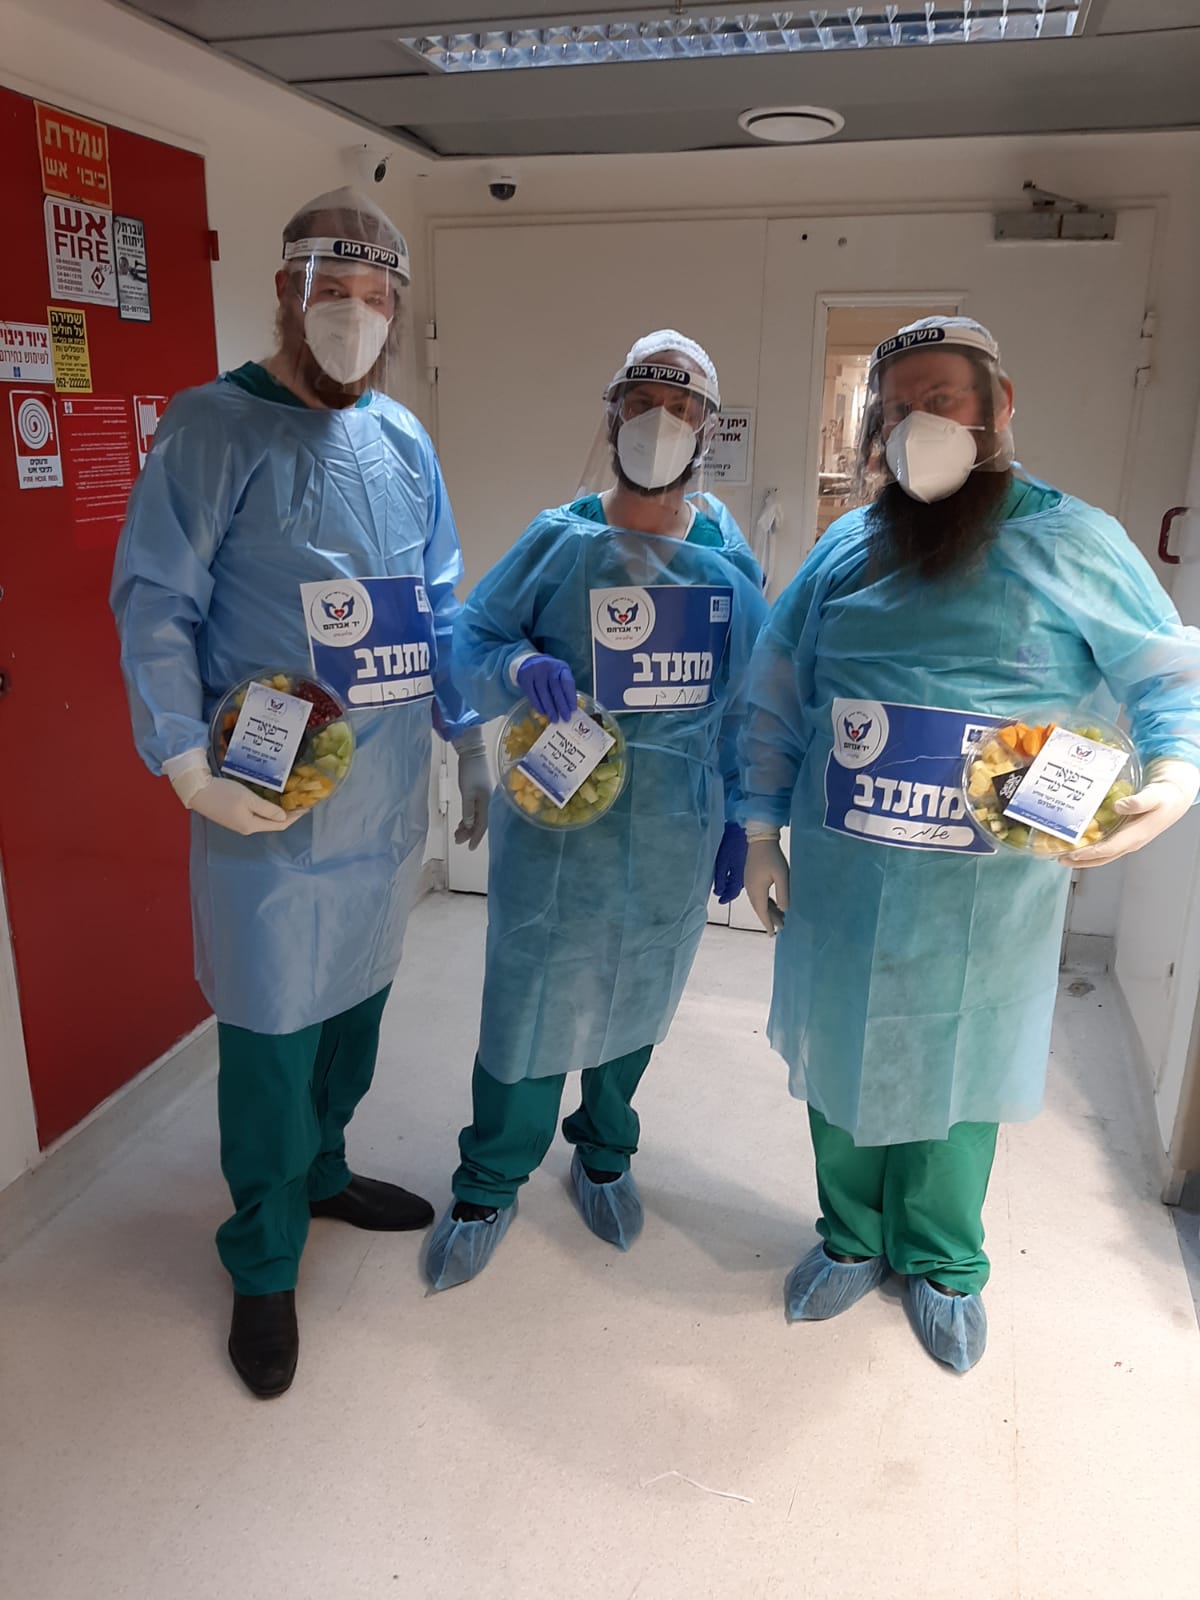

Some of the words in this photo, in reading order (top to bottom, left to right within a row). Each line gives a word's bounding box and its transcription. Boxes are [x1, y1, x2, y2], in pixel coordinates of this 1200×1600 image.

[45, 119, 102, 160] עמדת
[45, 157, 69, 179] אש
[77, 166, 106, 190] כיבוי
[53, 204, 106, 240] אש
[54, 231, 110, 264] FIRE
[340, 242, 362, 256] מגן
[364, 246, 397, 266] משקף
[51, 311, 83, 326] שמירה
[52, 323, 73, 336] חולים
[73, 324, 85, 337] על
[900, 328, 940, 347] משקף
[26, 331, 48, 348] ציוד
[24, 350, 49, 365] לשימוש
[880, 341, 897, 357] מגן
[630, 366, 649, 379] מגן
[650, 367, 686, 382] משקף
[727, 418, 748, 430] ניתן
[322, 622, 350, 631] אברהם
[354, 642, 430, 679] מתנדב
[632, 651, 713, 682] מתנדב
[853, 774, 969, 821] מתנדב
